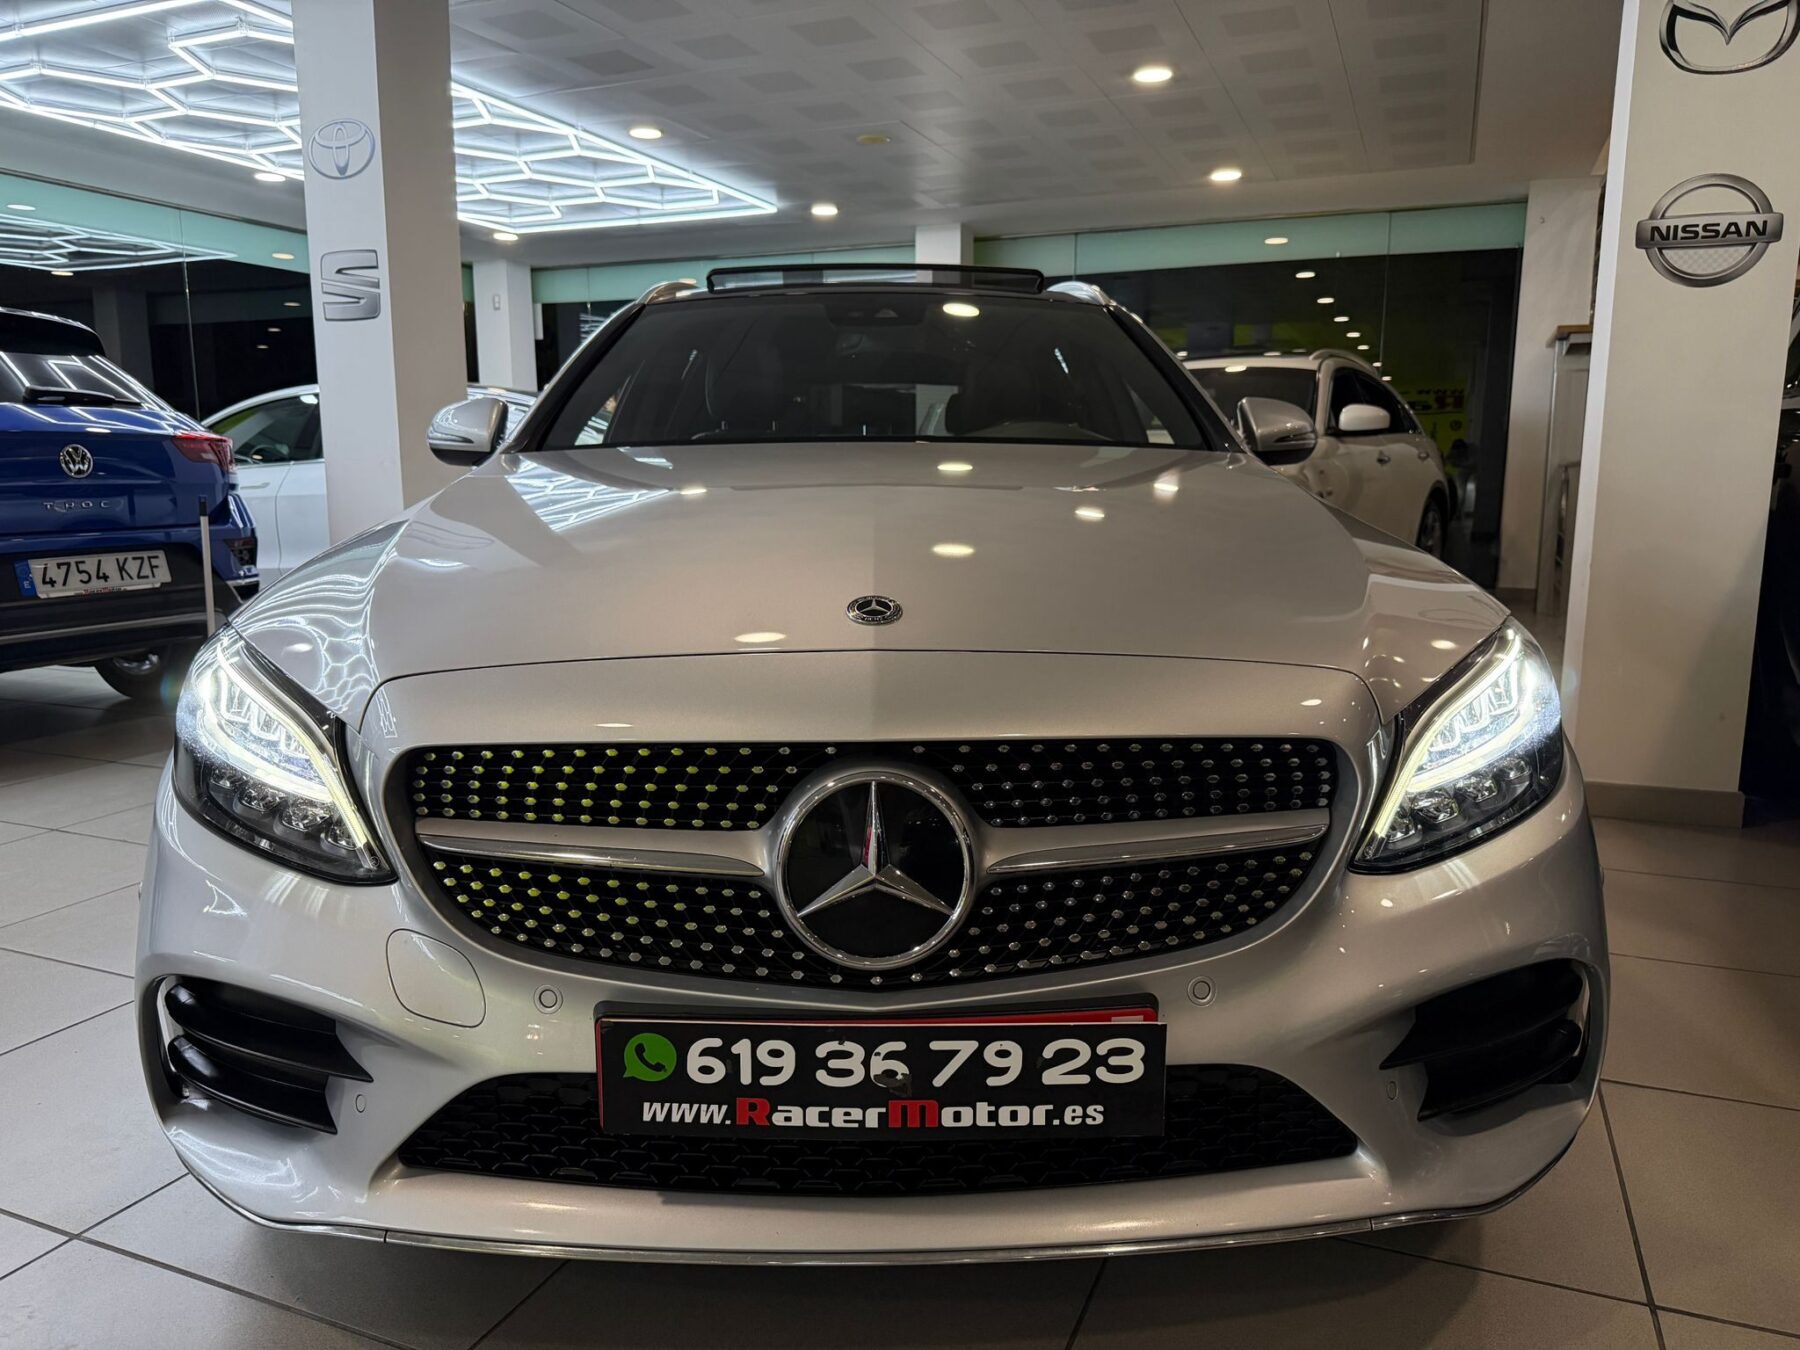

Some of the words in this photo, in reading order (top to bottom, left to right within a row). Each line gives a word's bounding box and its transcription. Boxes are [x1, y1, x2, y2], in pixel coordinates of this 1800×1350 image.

[1650, 219, 1768, 241] NISSAN
[41, 558, 110, 588] 4754
[115, 555, 160, 581] KZF
[686, 1037, 796, 1086] 619
[815, 1040, 911, 1088] 36
[929, 1040, 1023, 1087] 79
[1041, 1037, 1146, 1085] 23
[642, 1096, 1104, 1128] www.RacerMotor.es
